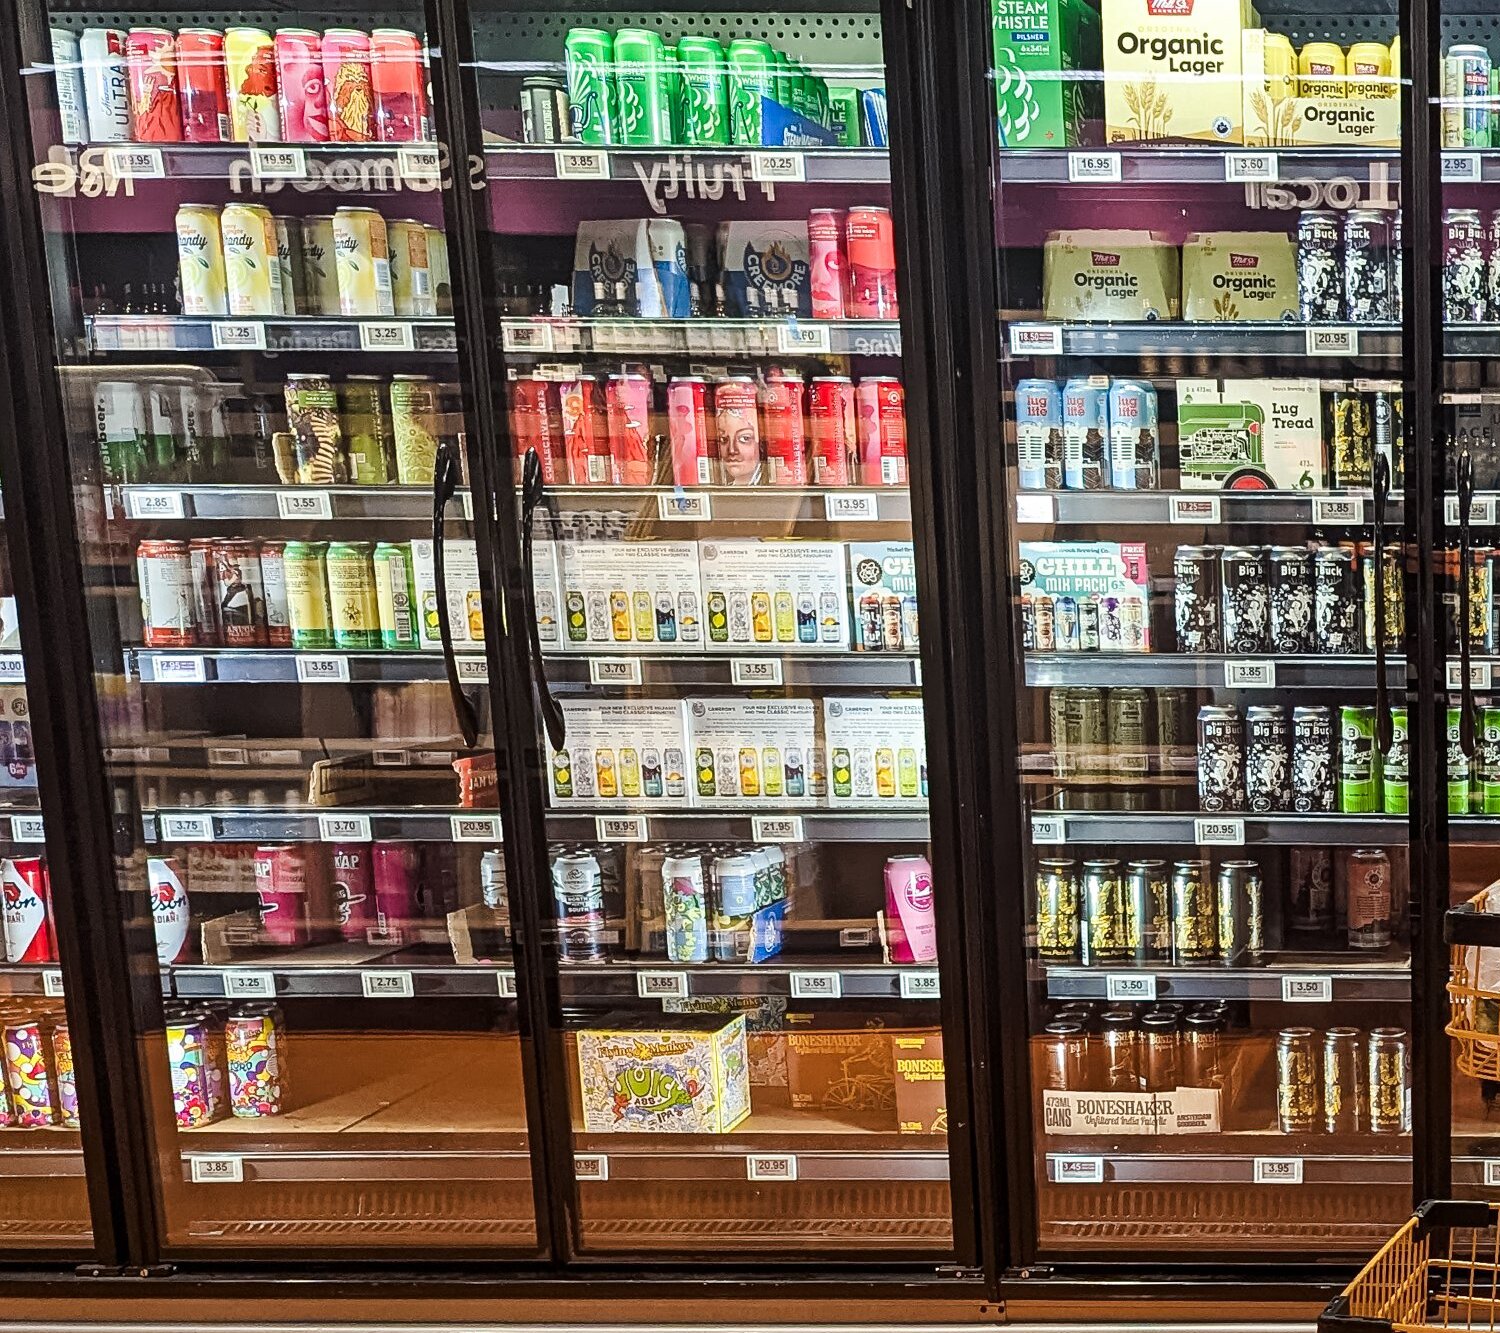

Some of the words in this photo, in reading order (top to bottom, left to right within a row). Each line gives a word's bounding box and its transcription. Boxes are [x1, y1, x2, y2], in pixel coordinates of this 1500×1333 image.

[999, 1, 1048, 14] STEAM
[1016, 33, 1044, 41] PILSNER
[1117, 33, 1224, 60] Organic
[1169, 58, 1224, 75] Lager
[1304, 106, 1376, 124] Organic
[1338, 124, 1376, 135] Lager
[263, 155, 292, 165] 19.95
[413, 155, 436, 165] 3.60
[571, 156, 593, 166] 3.85
[763, 157, 792, 168] 20.25
[1082, 159, 1109, 170] 16.95
[1241, 158, 1263, 170] 3.60
[1318, 229, 1338, 240] Buck
[1348, 229, 1370, 240] Buck
[1448, 228, 1467, 241] Big
[1074, 274, 1138, 291] Organic
[1213, 274, 1276, 292] Organic
[1105, 287, 1138, 299] Lager
[1244, 289, 1276, 300] Lager
[226, 326, 250, 338] 3.25
[374, 327, 398, 338] 3.25
[1019, 332, 1040, 342] 18.50
[1319, 334, 1346, 345] 20.95
[1027, 395, 1047, 408] lug
[1066, 395, 1085, 408] lug
[1118, 395, 1137, 408] lug
[1027, 405, 1048, 417] lite
[1066, 405, 1086, 417] lite
[1118, 405, 1138, 417] lite
[1272, 403, 1299, 416] Lug
[1272, 417, 1315, 430] Tread
[145, 497, 168, 508] 2.85
[293, 498, 315, 508] 3.55
[837, 499, 865, 510] 13.95
[1178, 502, 1198, 511] 19.25
[1327, 501, 1349, 513] 3.85
[1036, 558, 1116, 576] CHILL
[1177, 564, 1200, 575] Buck
[1238, 564, 1257, 577] Big
[1281, 564, 1299, 577] Big
[1319, 564, 1343, 576] Buck
[1046, 577, 1069, 592] MIX
[162, 661, 181, 670] 2.95
[311, 661, 334, 672] 3.65
[465, 662, 488, 672] 3.75
[604, 663, 627, 674] 3.70
[745, 663, 767, 674] 3.55
[1239, 666, 1261, 677] 3.85
[176, 821, 198, 831] 3.75
[334, 820, 356, 831] 3.70
[462, 820, 491, 831] 20.95
[607, 821, 636, 832] 19.95
[763, 821, 792, 832] 21.95
[1206, 825, 1234, 834] 20.95
[238, 977, 260, 988] 3.25
[376, 977, 399, 988] 2.75
[652, 978, 673, 988] 3.65
[804, 978, 826, 988] 3.65
[914, 978, 936, 988] 3.85
[1121, 980, 1143, 991] 3.50
[1296, 981, 1318, 992] 3.50
[788, 1034, 861, 1046] BONESHAKER
[597, 1044, 632, 1060] Flying
[650, 1040, 694, 1055] Monkeys
[1046, 1097, 1071, 1108] 473ML
[1077, 1099, 1175, 1116] BONESHAKER
[657, 1110, 674, 1123] IPA
[1046, 1108, 1072, 1127] CANS
[206, 1162, 229, 1173] 3.85
[758, 1160, 786, 1171] 20.95
[1063, 1162, 1081, 1171] 3.45
[1268, 1162, 1290, 1173] 3.95
